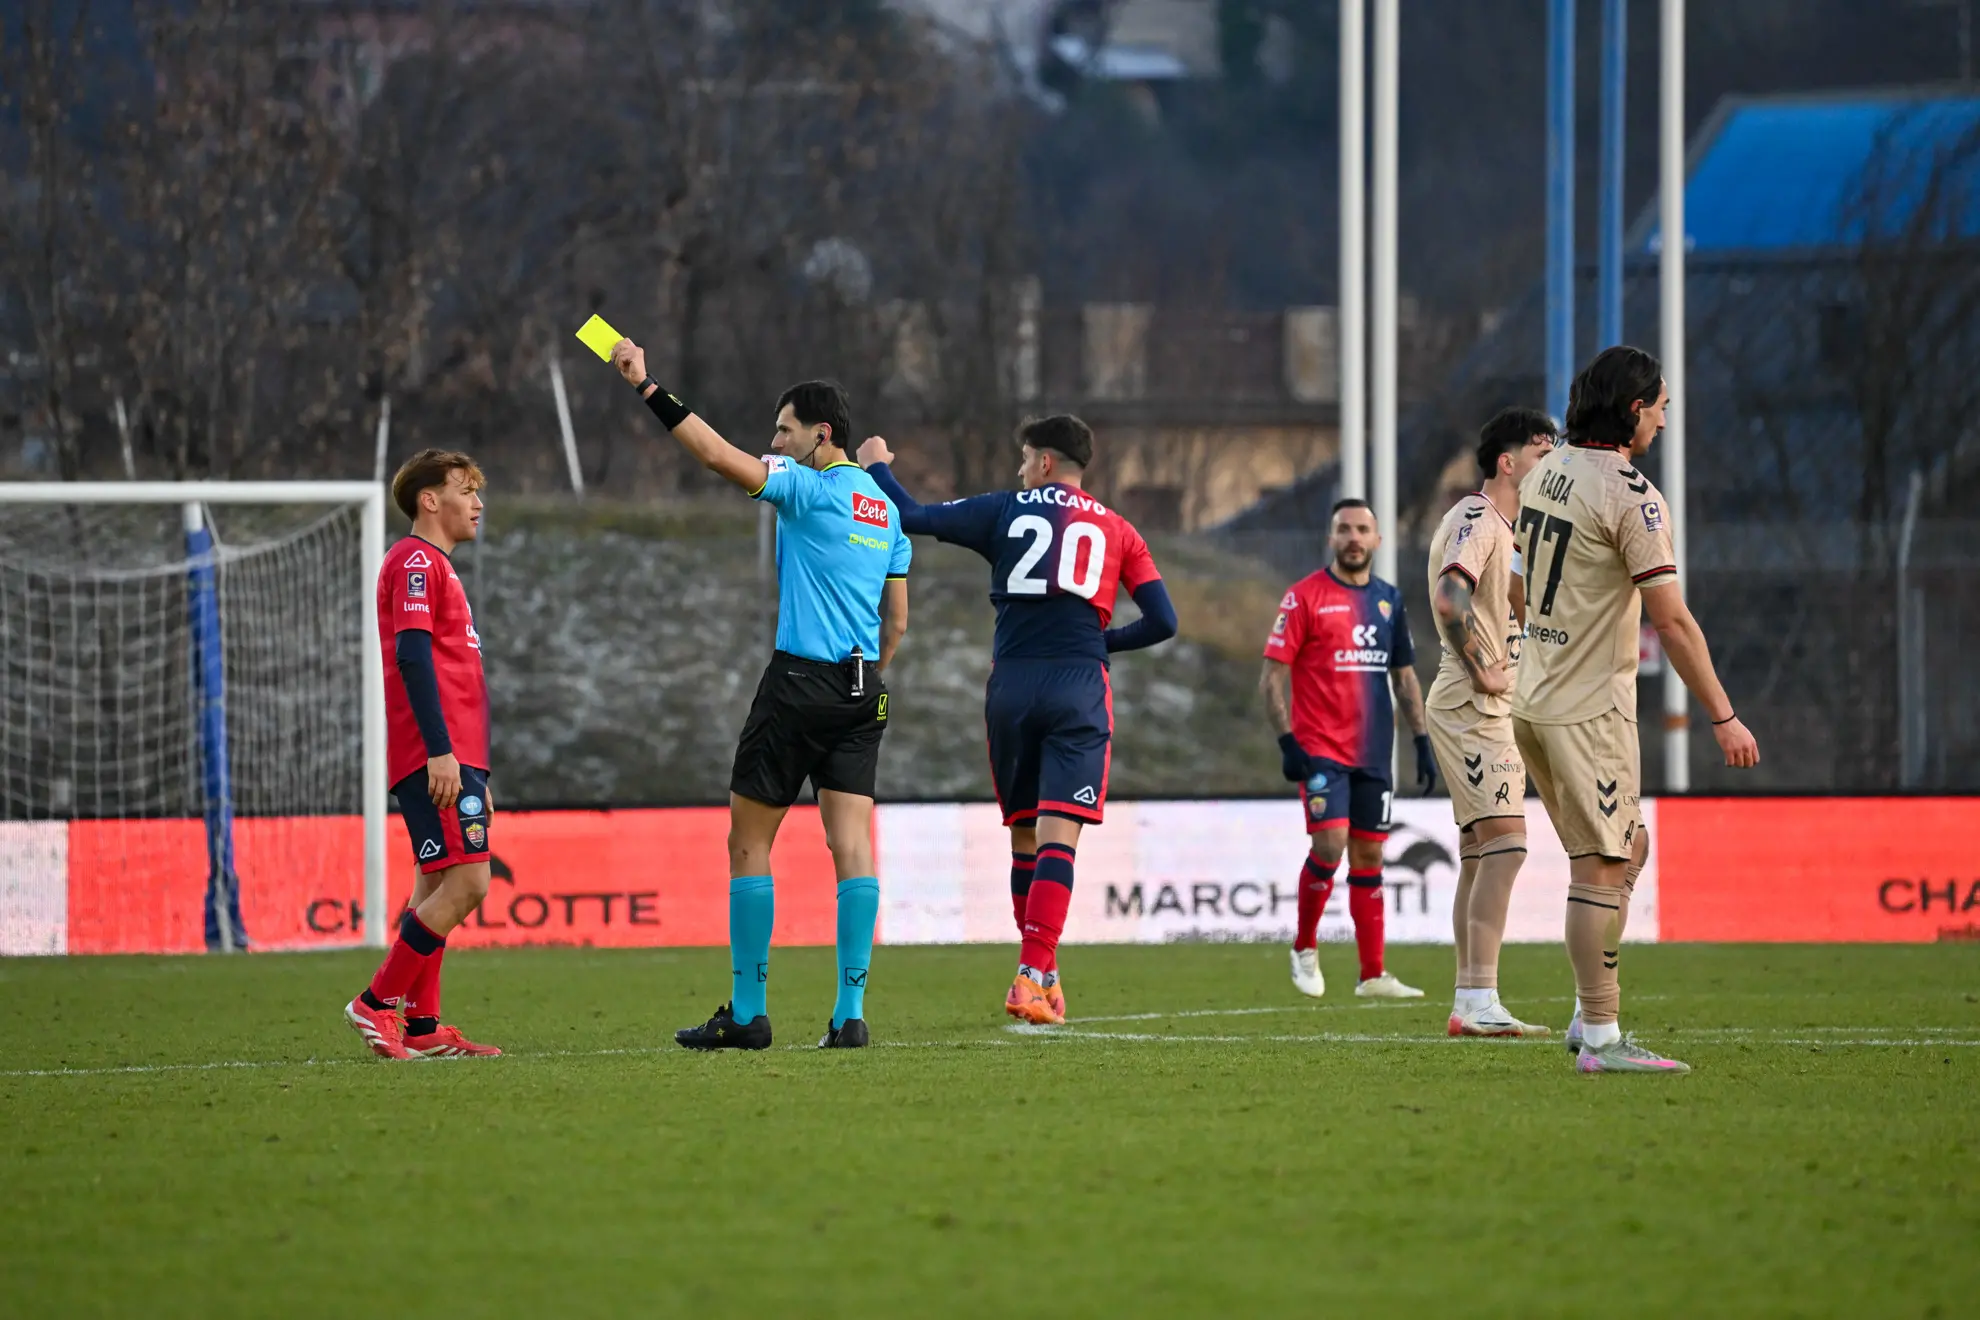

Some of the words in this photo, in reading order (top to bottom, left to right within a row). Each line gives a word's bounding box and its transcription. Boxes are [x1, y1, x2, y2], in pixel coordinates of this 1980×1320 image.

[1016, 486, 1106, 515] CACCAVO
[1538, 468, 1575, 506] RADA
[854, 498, 888, 522] Lete
[1007, 514, 1106, 600] 20
[1520, 505, 1573, 617] 77
[1104, 881, 1430, 918] MARCHTI
